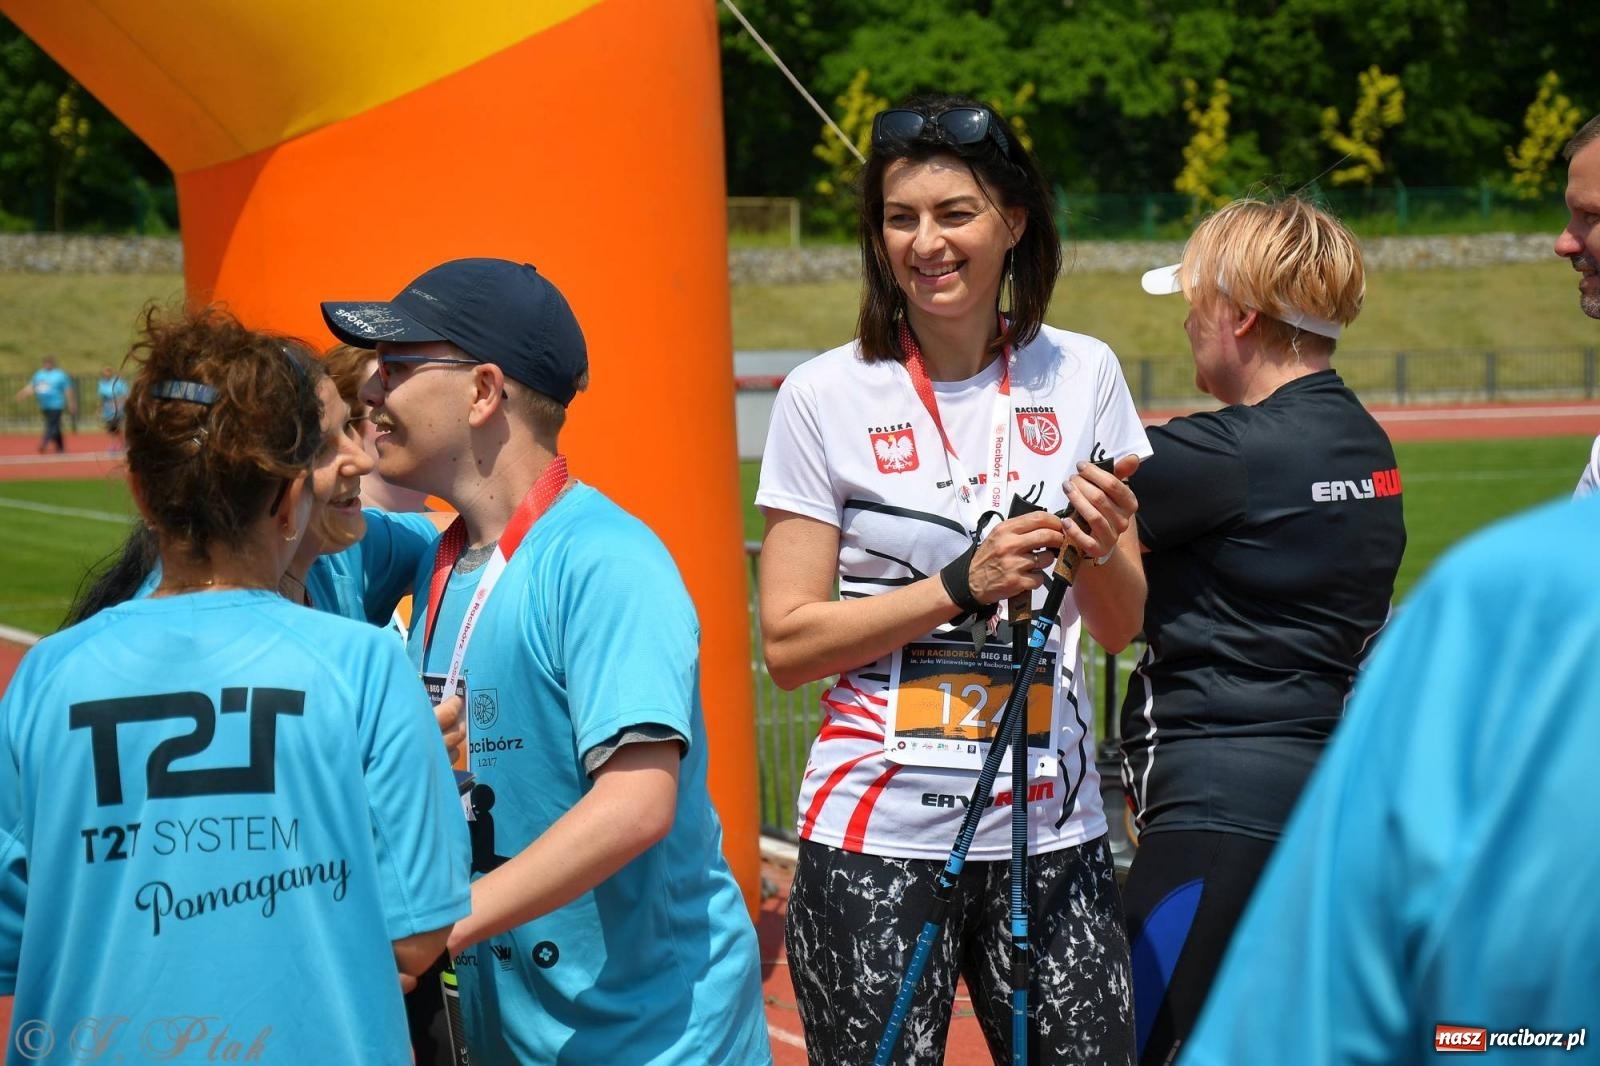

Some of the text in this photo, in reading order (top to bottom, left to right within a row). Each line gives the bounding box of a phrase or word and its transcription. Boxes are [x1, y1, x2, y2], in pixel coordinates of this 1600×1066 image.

[336, 309, 375, 333] SPORTS
[867, 422, 912, 433] POLSKA
[994, 437, 1004, 478] Racibórz
[927, 649, 978, 659] RACIBORSK
[981, 652, 1000, 660] BIEG
[69, 687, 306, 808] T2T
[478, 757, 497, 768] 1217
[81, 816, 300, 864] T2T SYSTEM
[135, 858, 352, 936] Pomagamy
